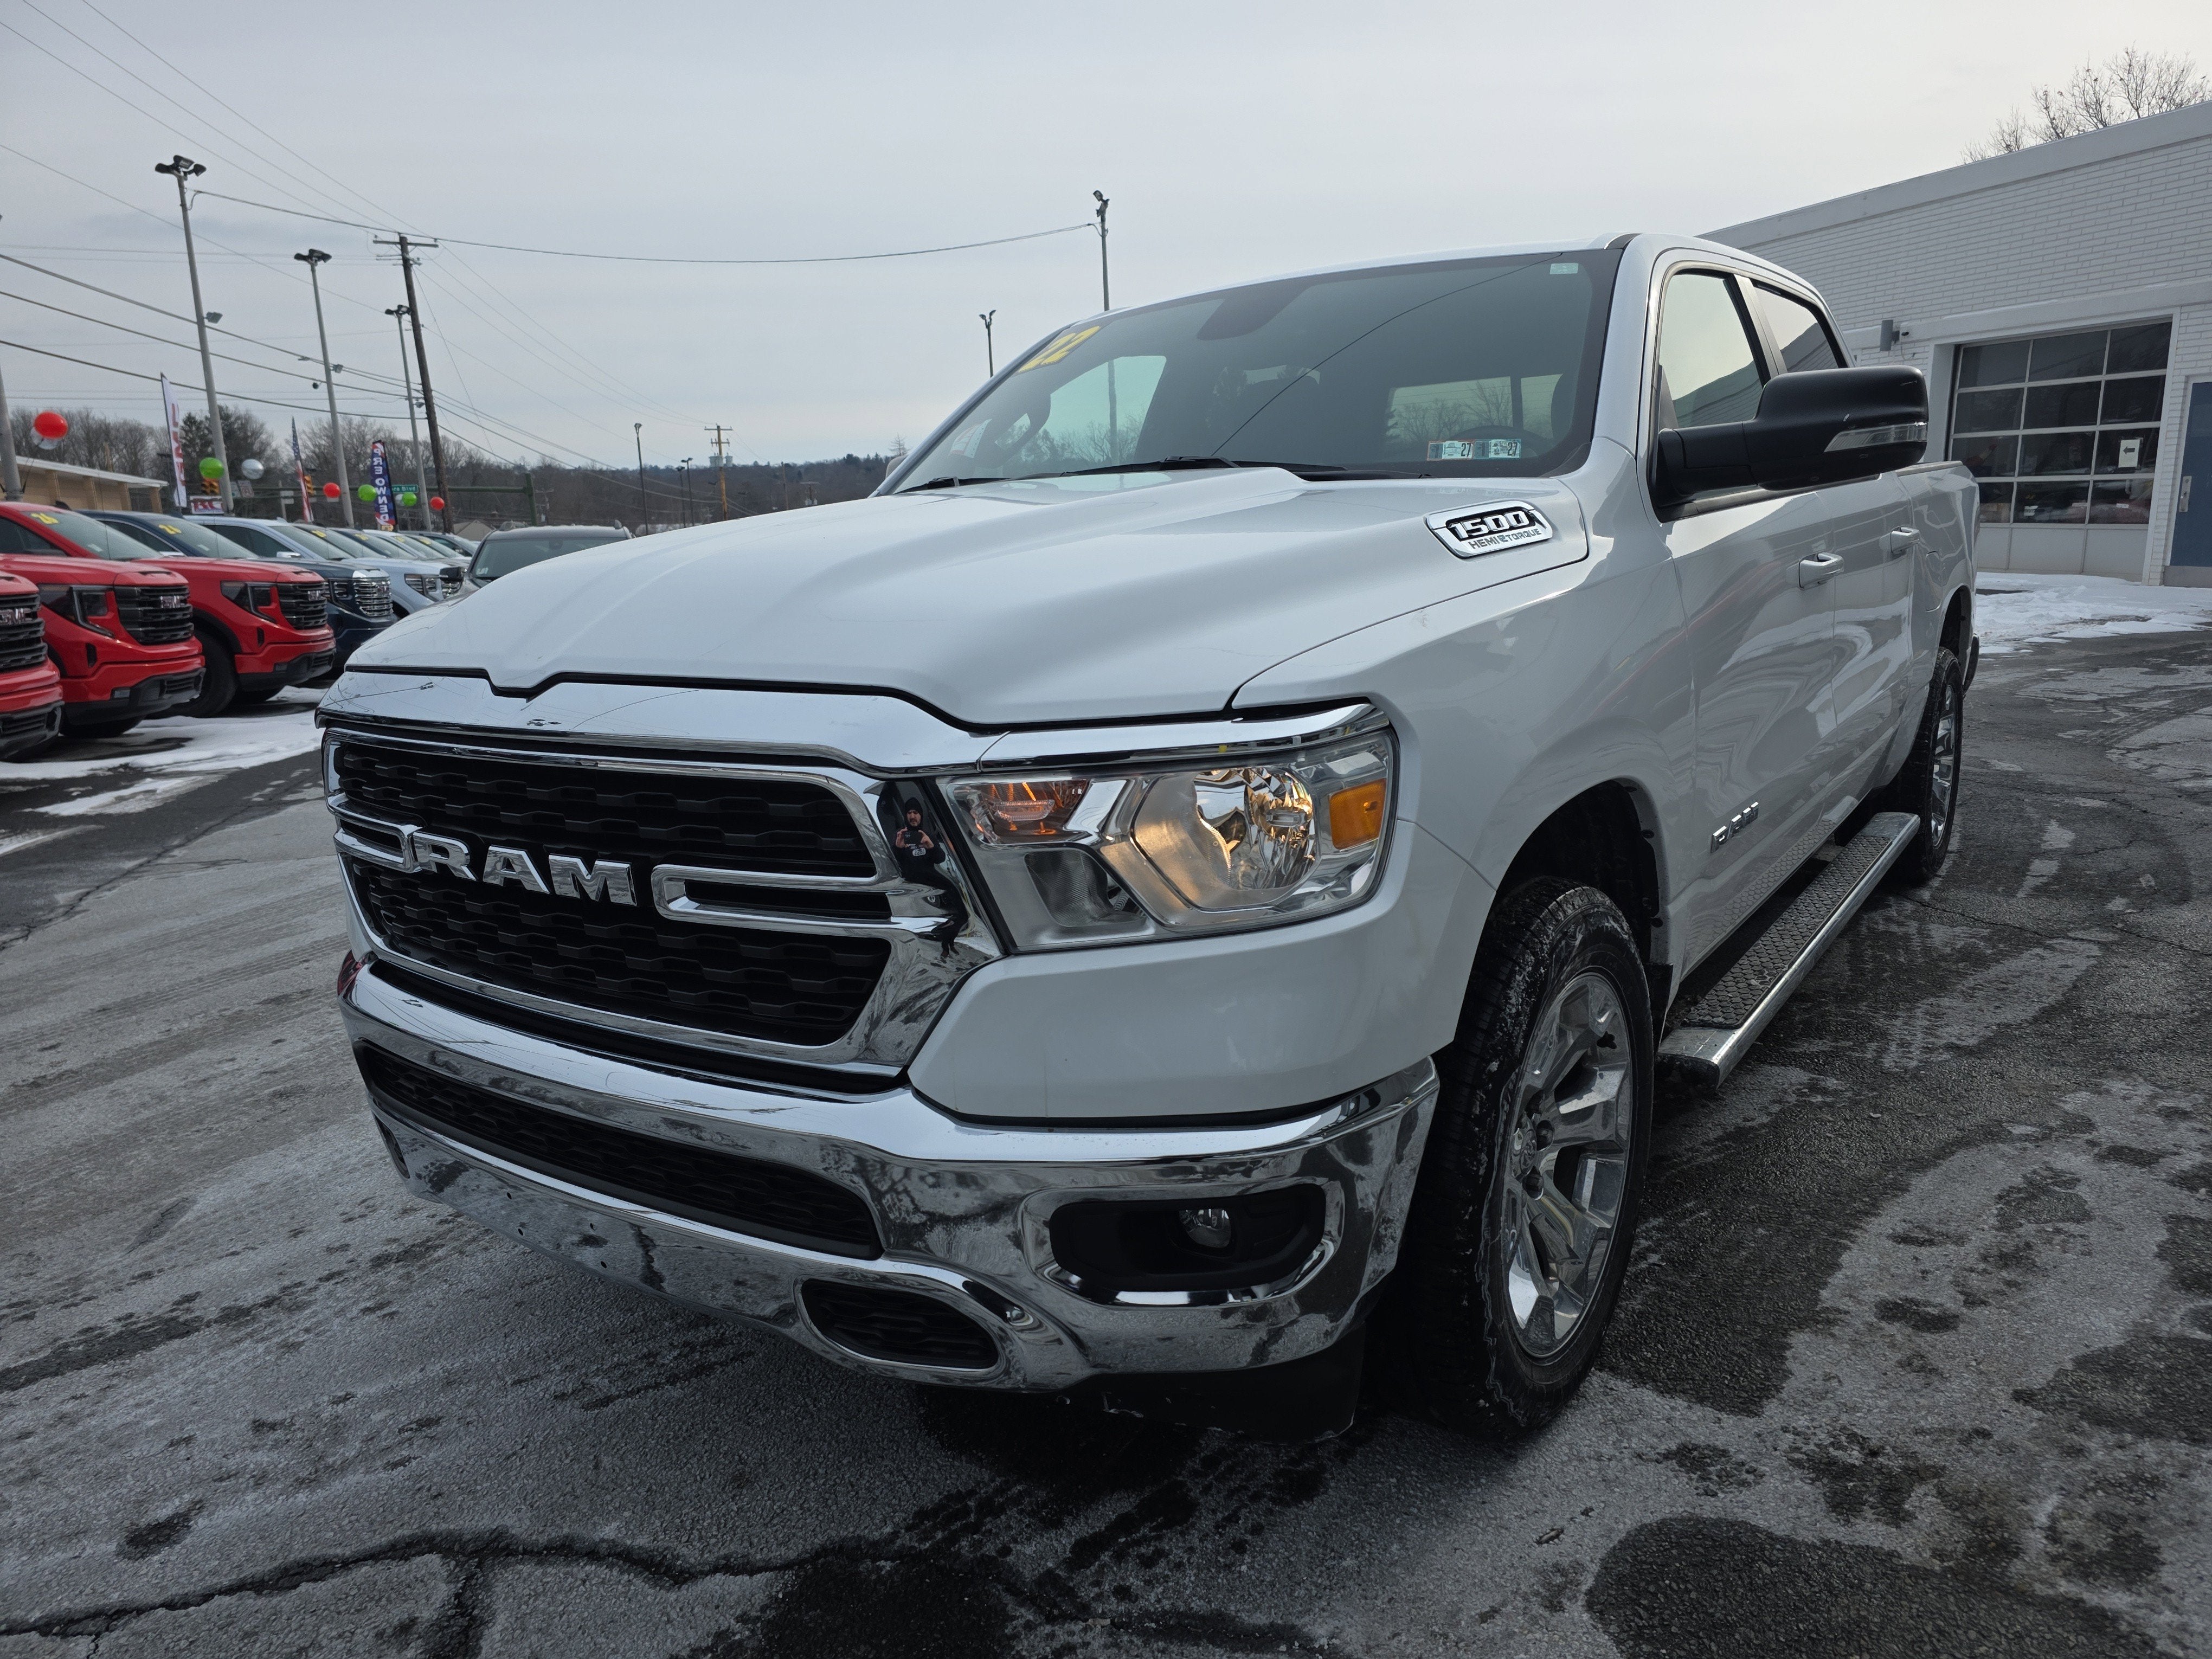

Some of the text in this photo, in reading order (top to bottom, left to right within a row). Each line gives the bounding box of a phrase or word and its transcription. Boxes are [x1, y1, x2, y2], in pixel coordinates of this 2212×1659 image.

[1019, 326, 1100, 372] 22
[1461, 443, 1471, 457] 27
[1507, 442, 1518, 456] 27
[1449, 511, 1529, 539] 1500
[1468, 536, 1500, 549] HEMI
[413, 831, 638, 907] RAM
